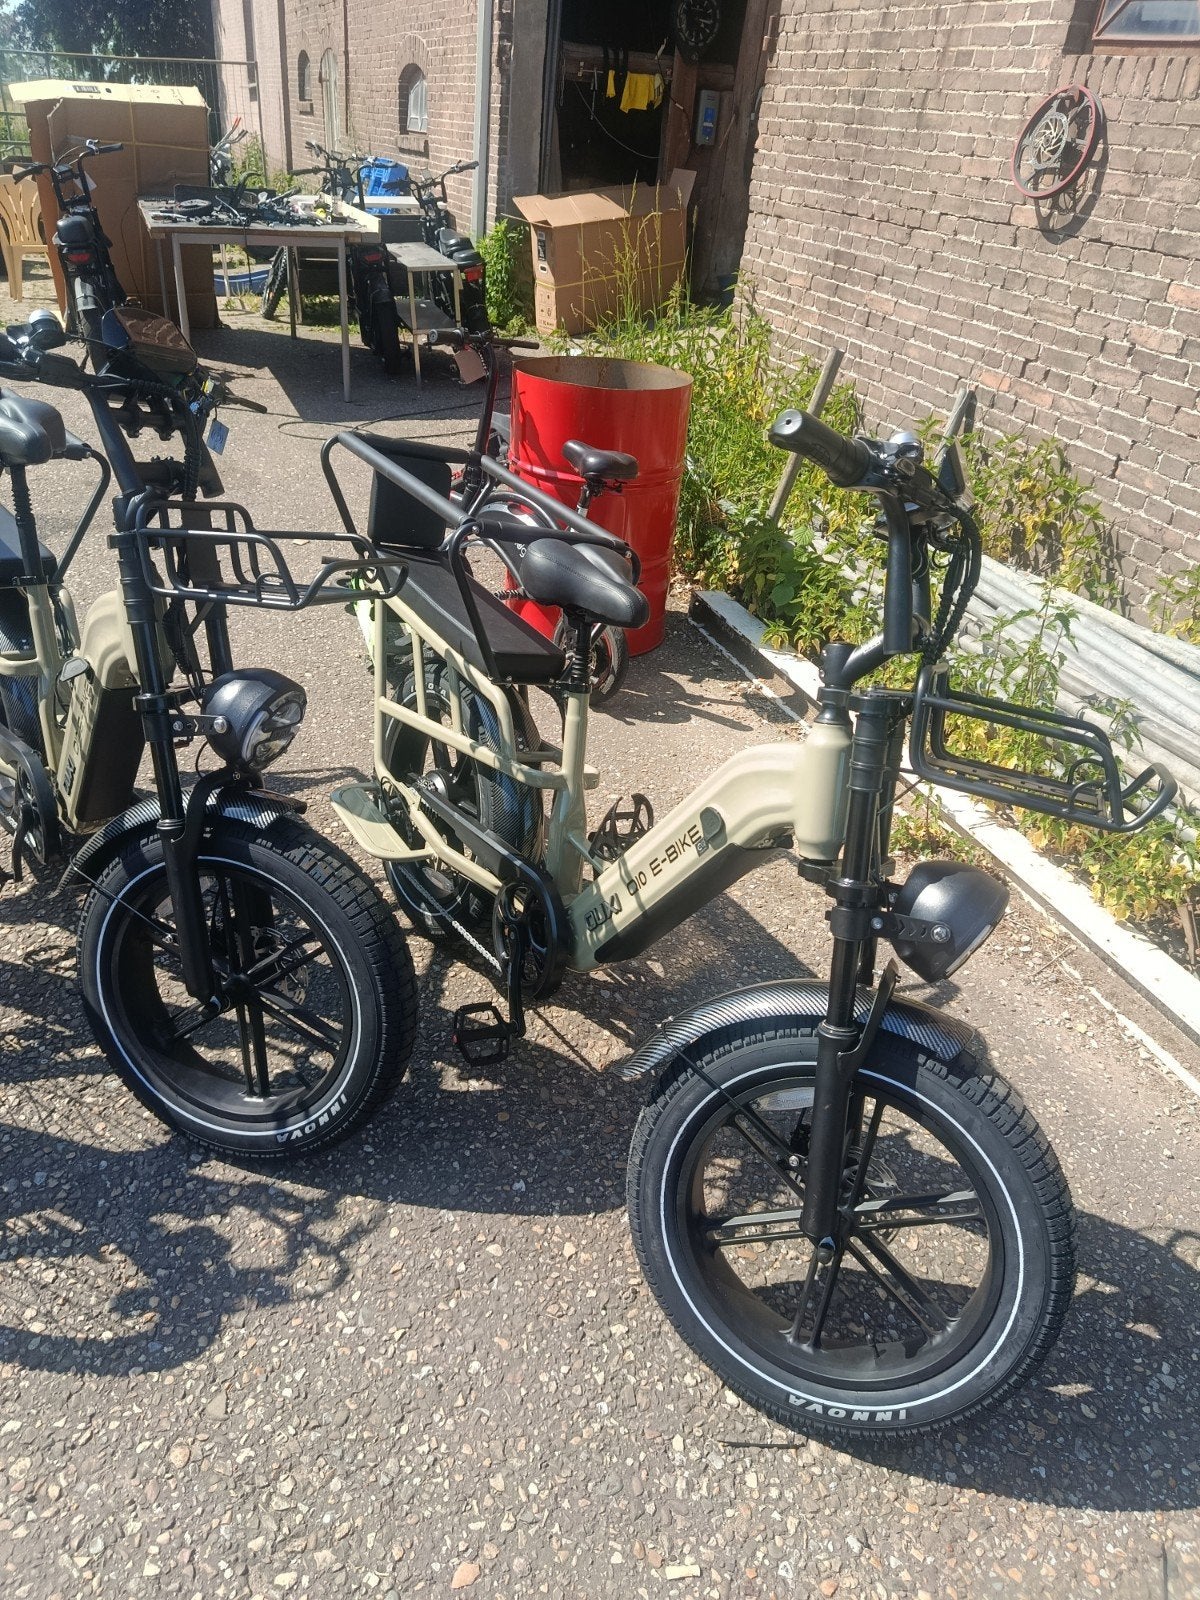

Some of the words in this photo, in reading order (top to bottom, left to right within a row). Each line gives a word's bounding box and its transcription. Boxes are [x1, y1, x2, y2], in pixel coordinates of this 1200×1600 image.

[649, 824, 703, 877] E-BIKE
[276, 1093, 348, 1143] INNOVA
[788, 1394, 907, 1422] INNOVA
